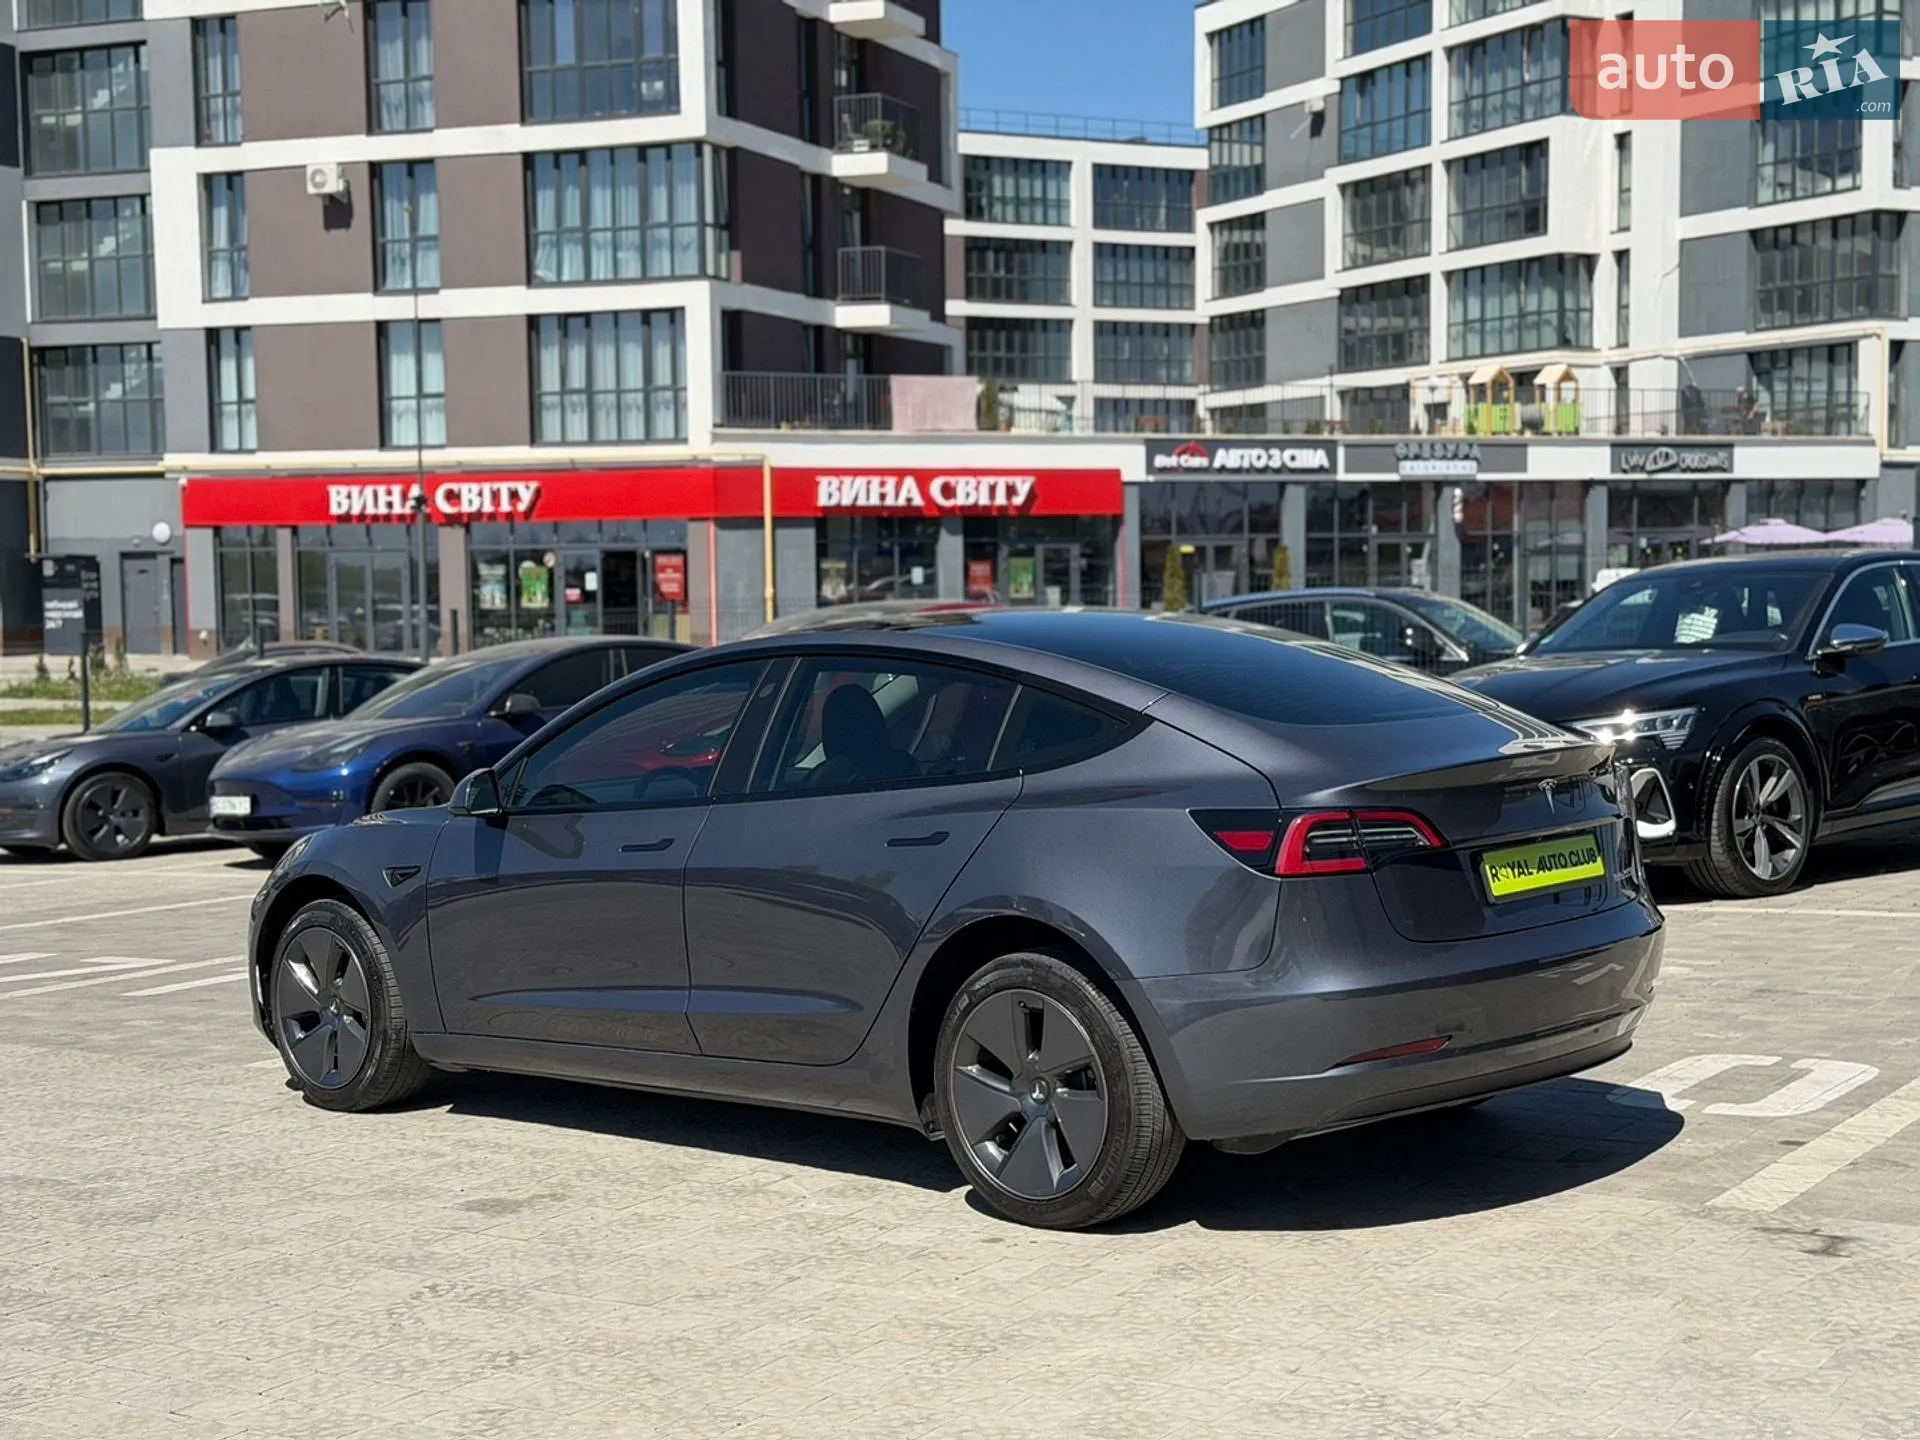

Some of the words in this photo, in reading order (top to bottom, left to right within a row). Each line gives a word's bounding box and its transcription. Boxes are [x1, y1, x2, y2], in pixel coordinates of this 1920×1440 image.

[1213, 449, 1267, 468] АВТО
[1282, 449, 1329, 468] США
[327, 483, 429, 515] ВИНА
[435, 481, 540, 515] СВІТУ
[816, 475, 925, 507] ВИНА
[929, 475, 1036, 507] СВІТУ
[1537, 852, 1568, 875] AUTO
[1569, 847, 1598, 867] CLUB
